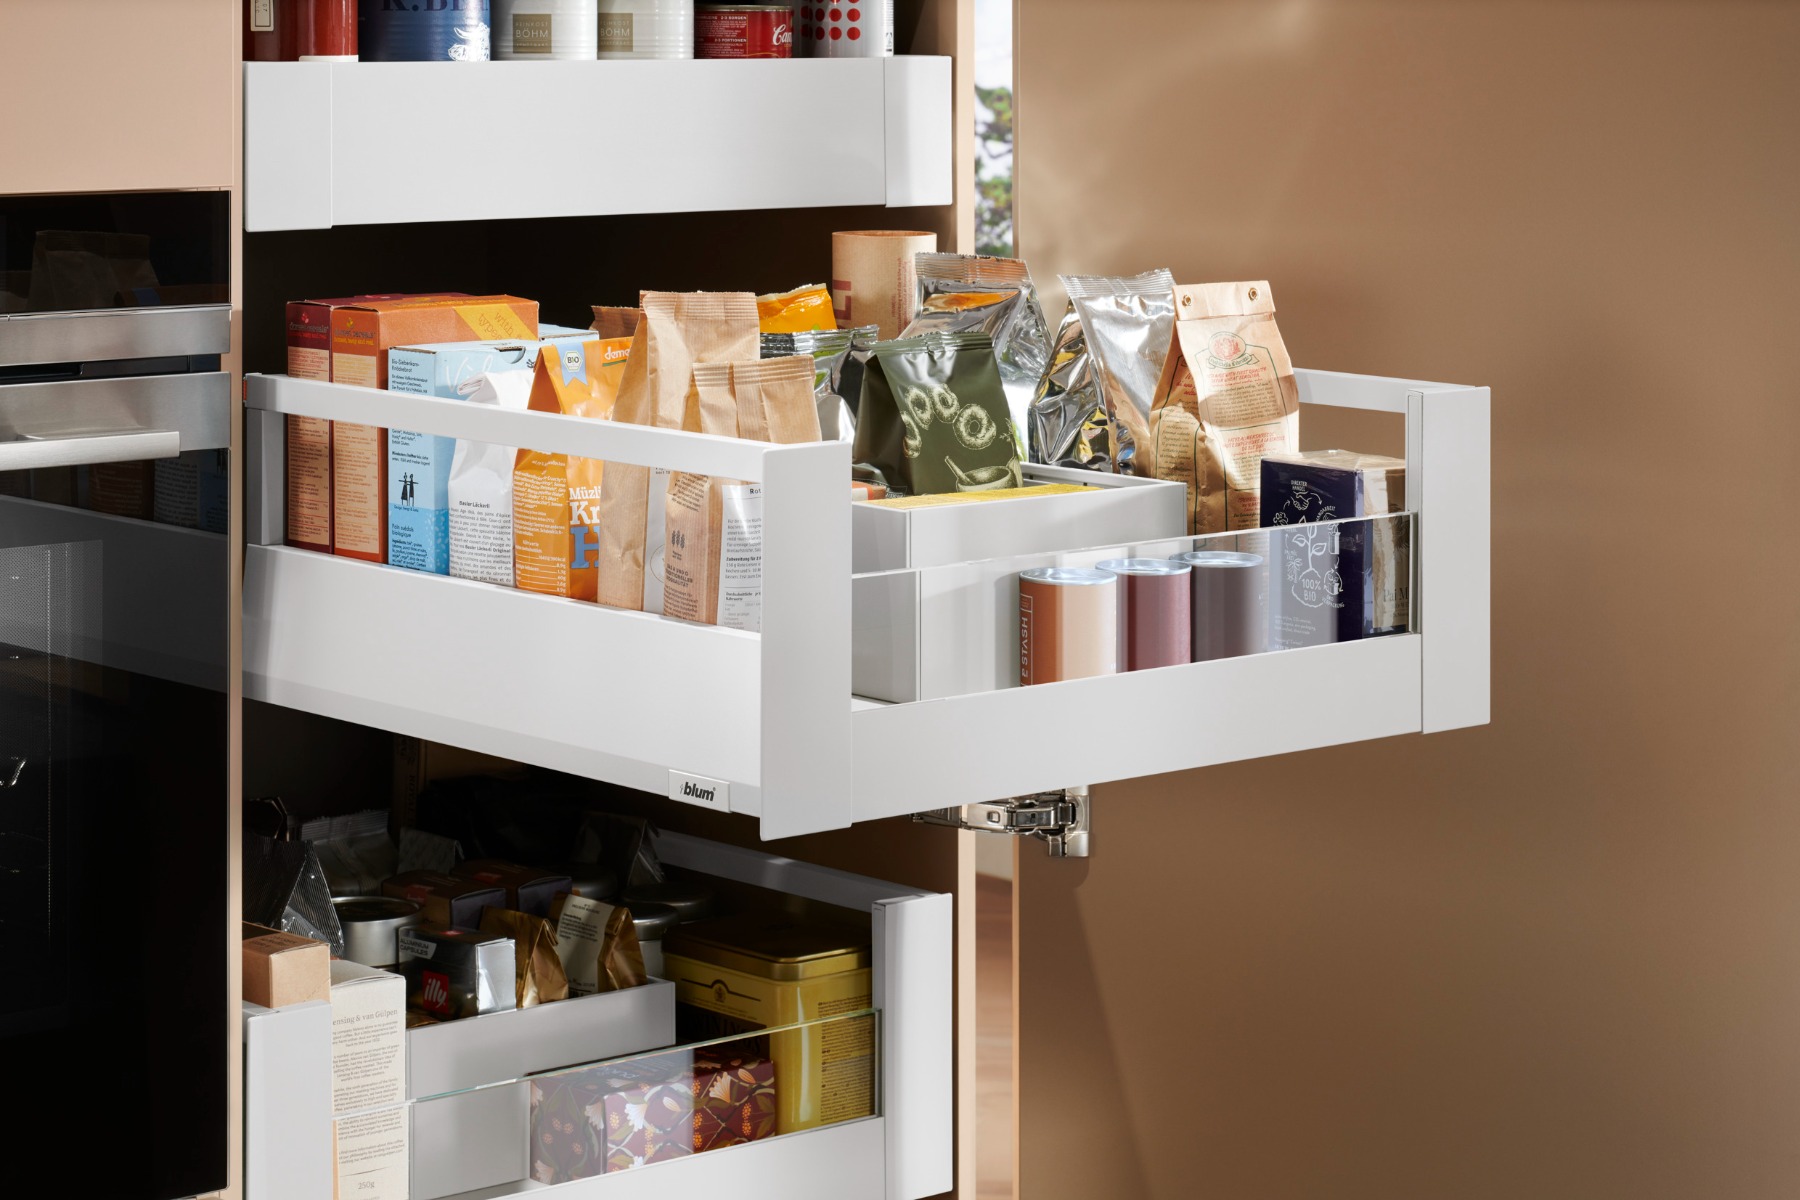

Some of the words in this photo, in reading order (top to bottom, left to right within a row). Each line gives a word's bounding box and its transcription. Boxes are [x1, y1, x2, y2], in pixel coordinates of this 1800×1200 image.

[515, 28, 549, 38] BÖHM
[600, 28, 630, 37] BÖHM
[567, 356, 580, 364] BIO
[568, 486, 601, 500] Müzli
[569, 500, 600, 524] Kr
[1302, 578, 1322, 591] 100%
[1304, 590, 1317, 602] BIO
[683, 781, 715, 802] blum
[400, 944, 428, 956] CAPSULES
[424, 978, 447, 1008] illy
[332, 1016, 355, 1026] ensing
[355, 1014, 361, 1022] &
[362, 1013, 375, 1021] van
[358, 1181, 375, 1190] 250g
